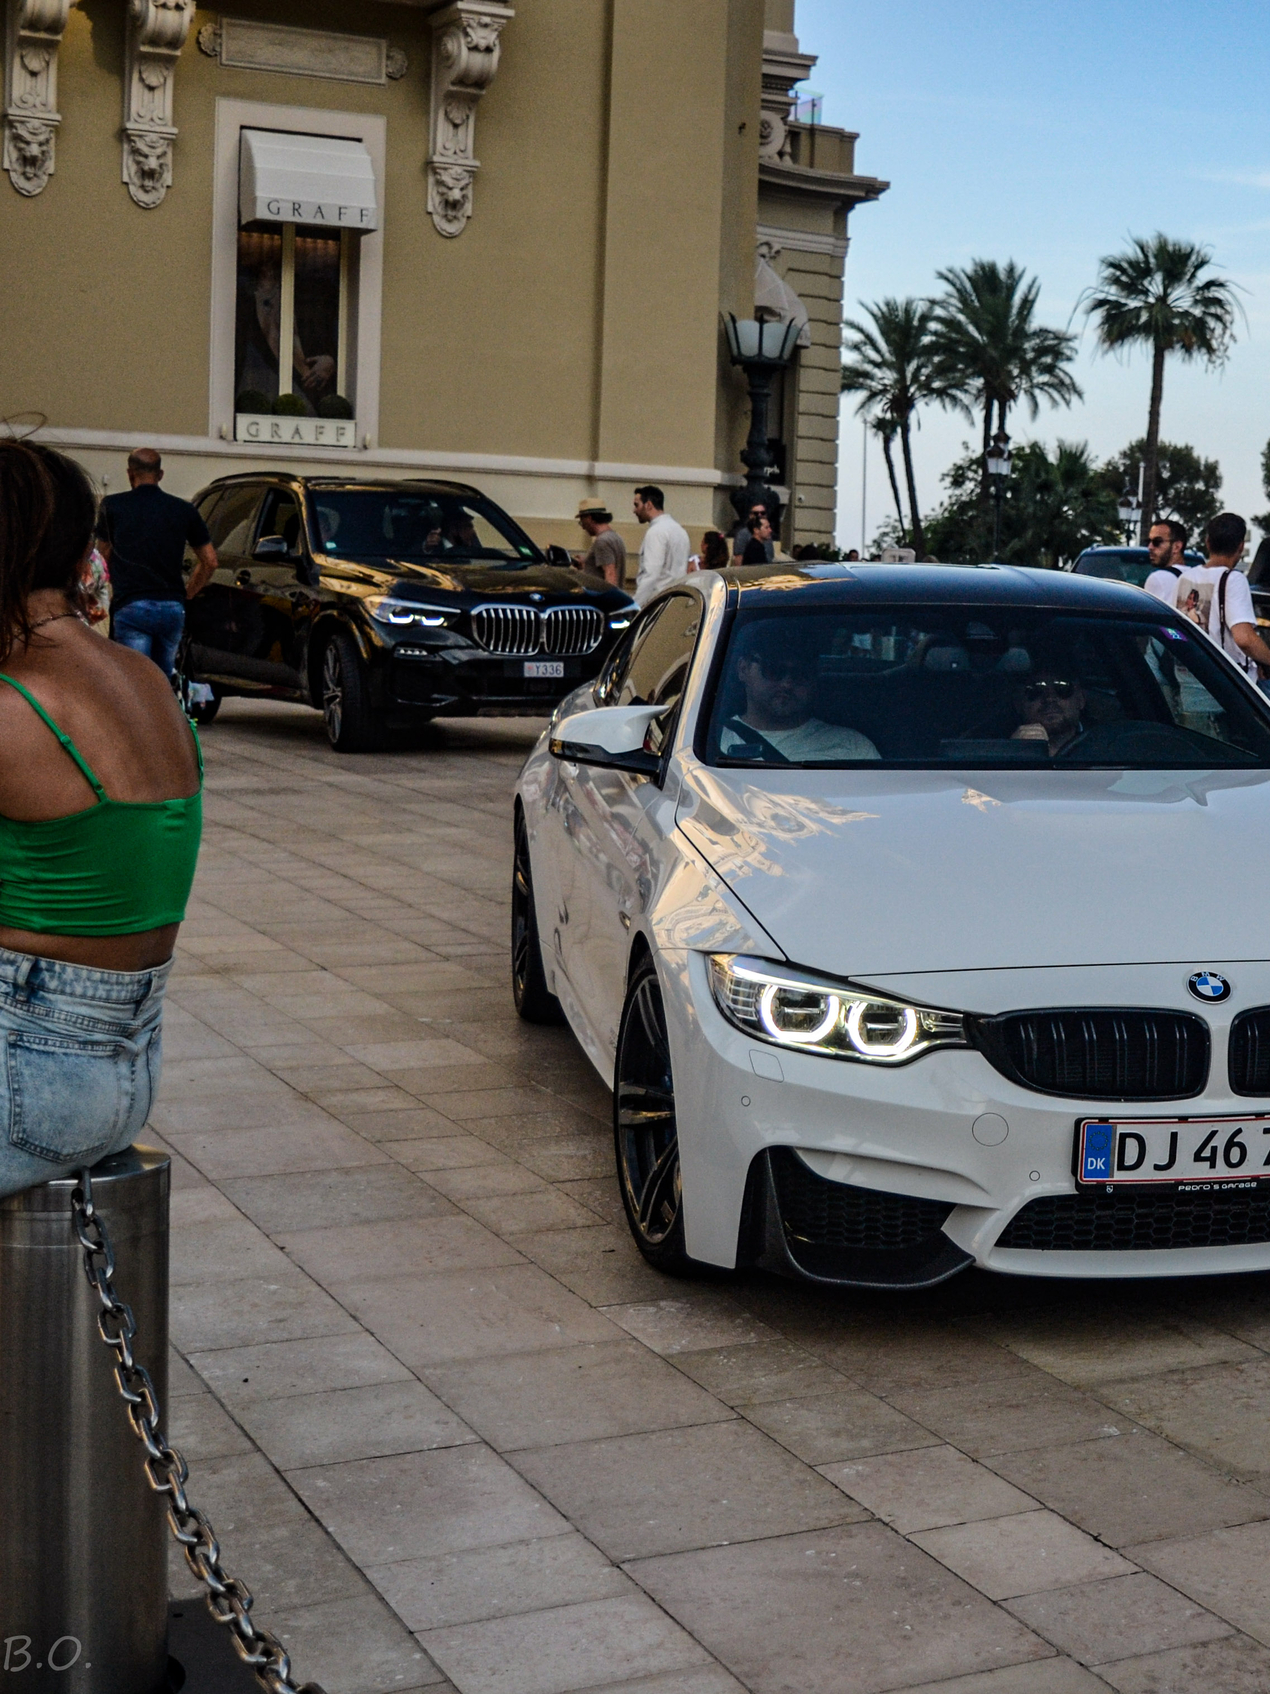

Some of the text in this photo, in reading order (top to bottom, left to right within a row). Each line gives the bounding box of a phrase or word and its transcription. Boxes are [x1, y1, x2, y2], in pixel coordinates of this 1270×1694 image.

[266, 199, 369, 223] GRAFF
[246, 421, 346, 442] GRAFF
[1116, 1131, 1179, 1171] DJ
[1193, 1127, 1248, 1170] 46
[1087, 1157, 1106, 1170] DK
